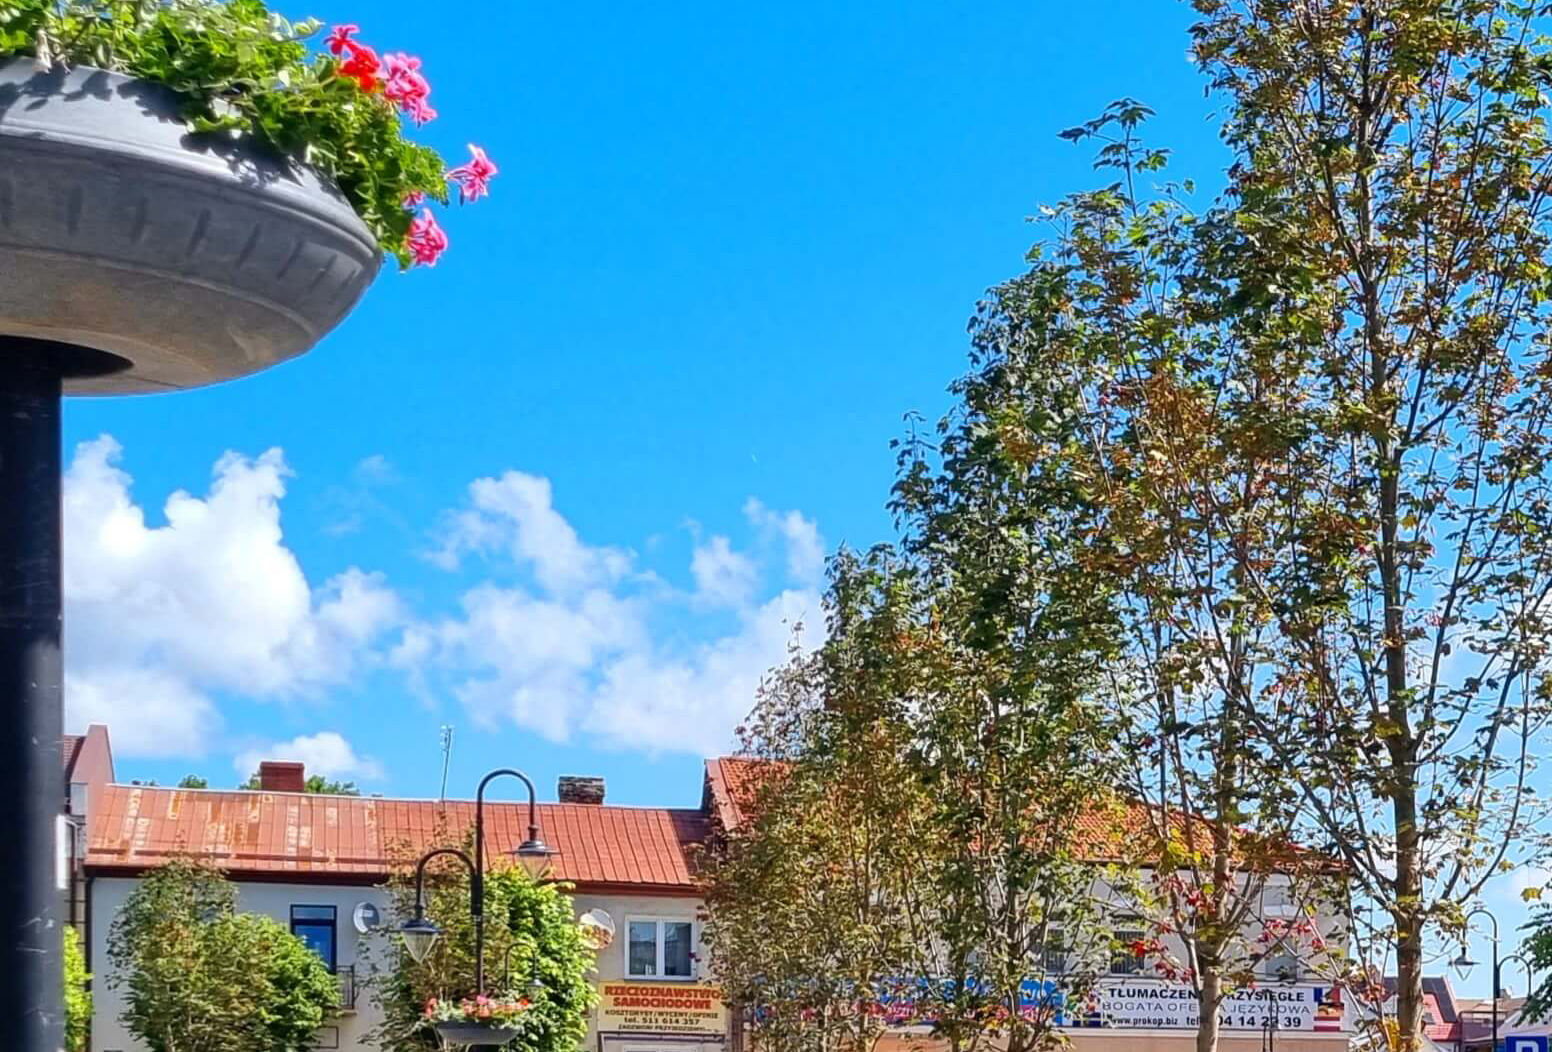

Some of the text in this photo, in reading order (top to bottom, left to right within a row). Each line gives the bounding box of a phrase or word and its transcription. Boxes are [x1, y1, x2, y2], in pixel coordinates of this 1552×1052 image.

[605, 985, 720, 999] RZECZOZNAWSTWO
[1108, 988, 1200, 1000] TŁUMACZEN
[613, 997, 712, 1009] SAMOCHODOWE
[1102, 1001, 1164, 1011] BOGATA
[1238, 1015, 1256, 1027] 14
[1284, 1016, 1302, 1028] 39
